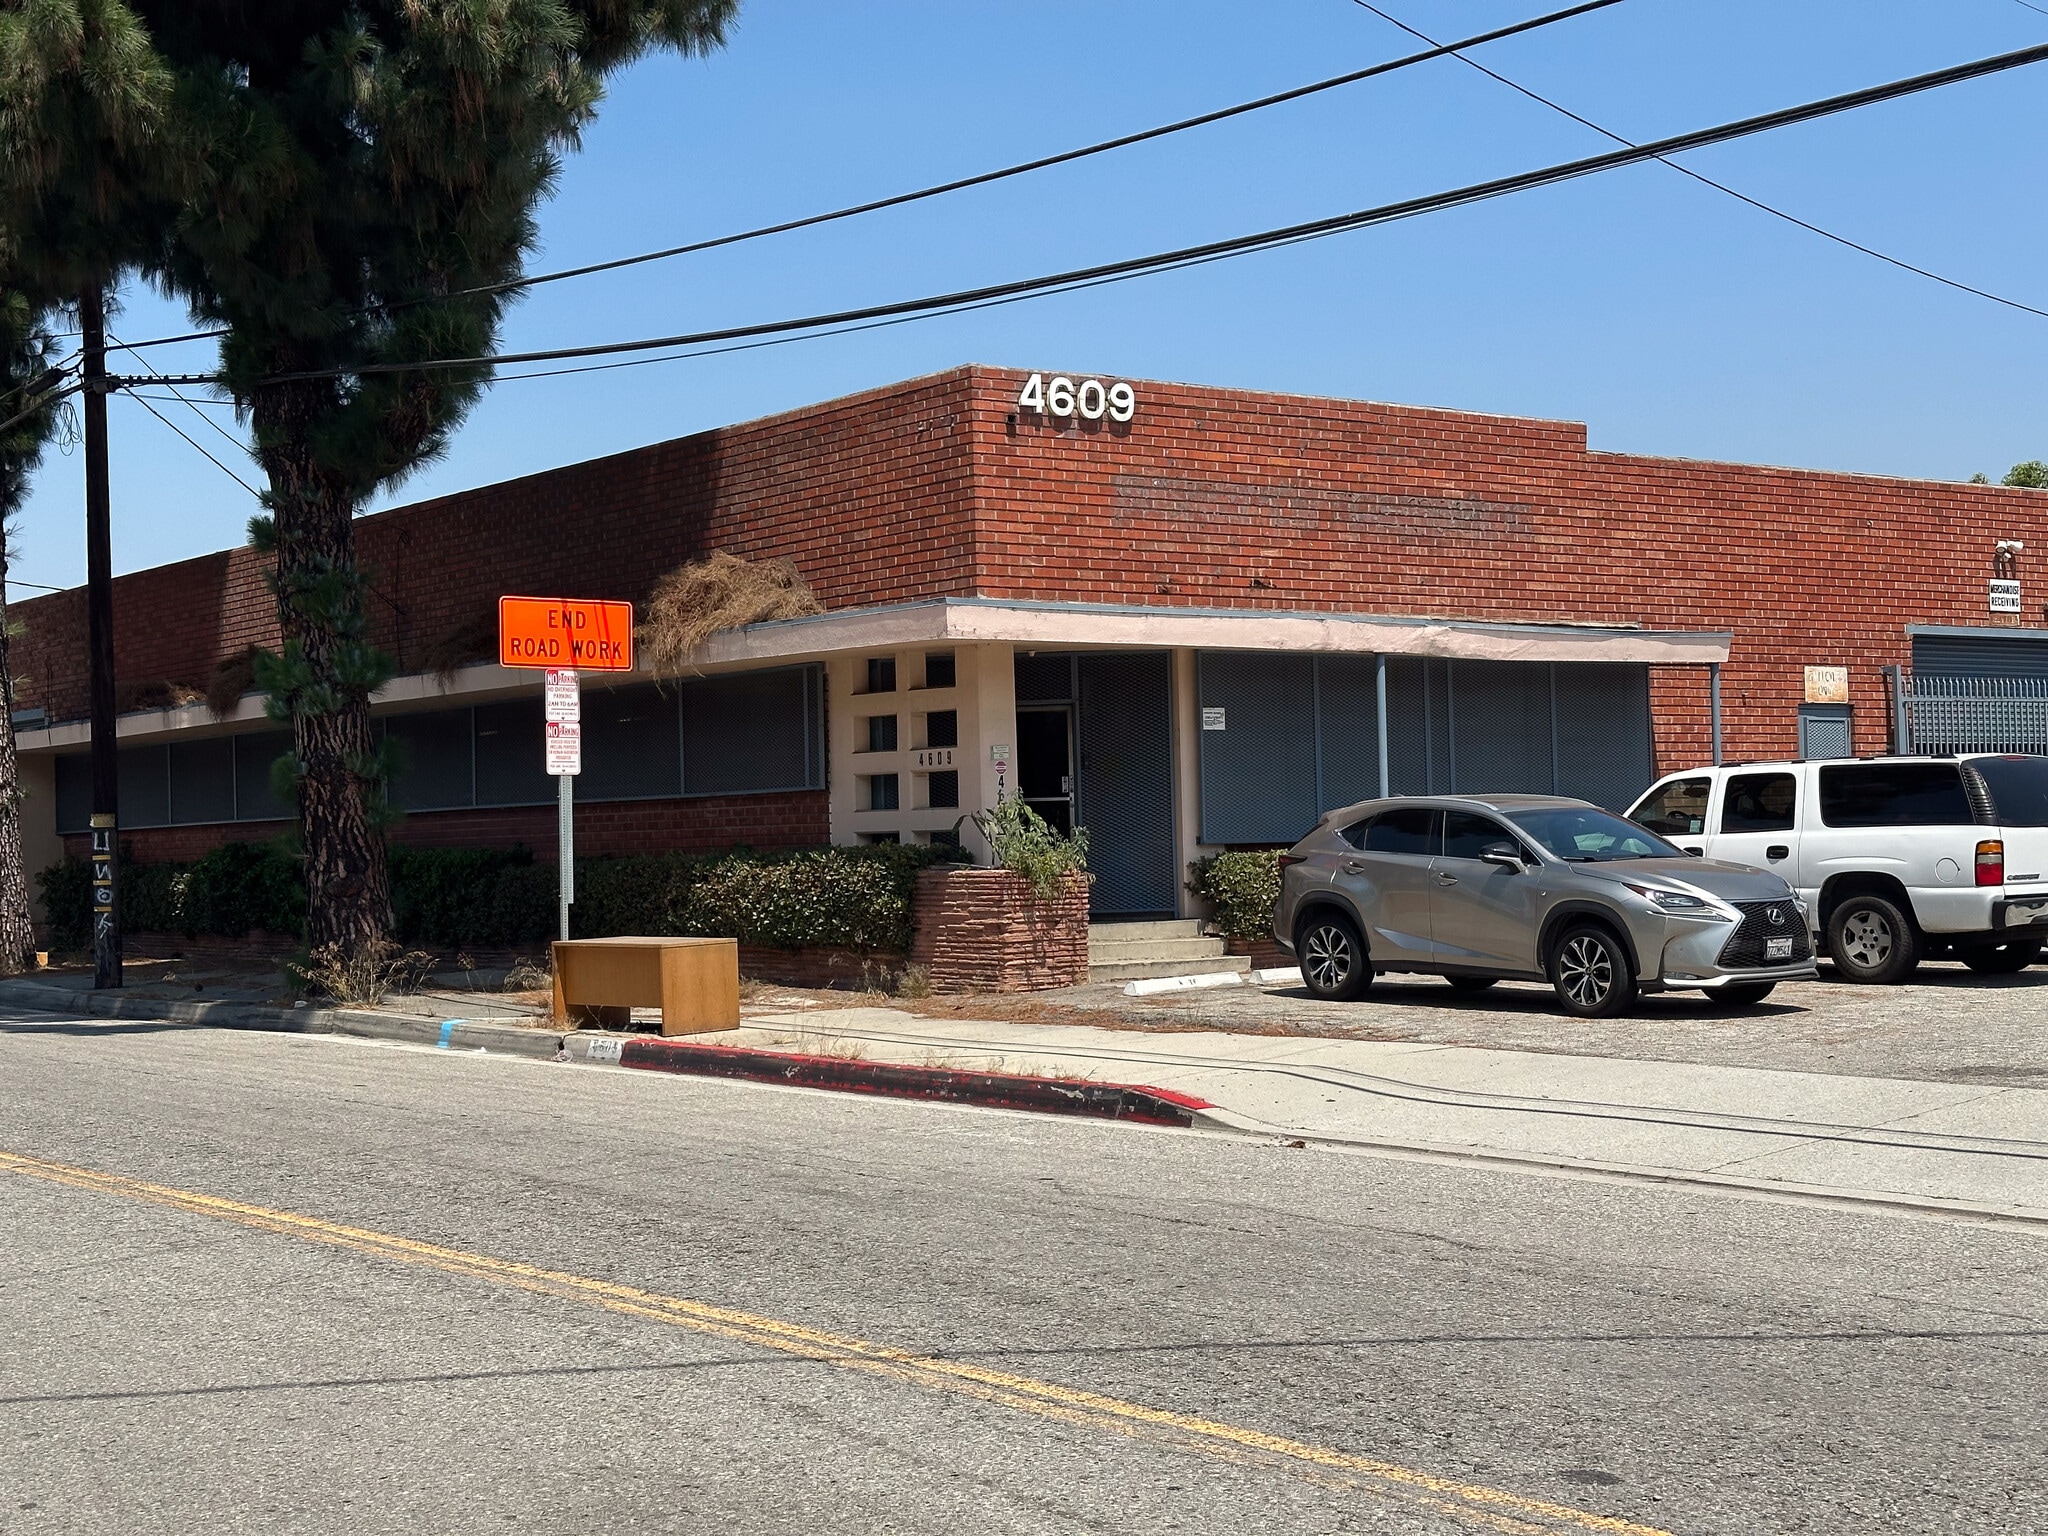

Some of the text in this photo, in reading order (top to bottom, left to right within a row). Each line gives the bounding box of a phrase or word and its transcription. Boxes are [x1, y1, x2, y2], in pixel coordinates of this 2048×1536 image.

[1018, 373, 1135, 422] 4609
[1990, 584, 2019, 595] MERCHANDISE
[1991, 596, 2019, 607] RECEIVING
[548, 609, 586, 630] END
[510, 637, 622, 660] ROAD WORK
[547, 673, 578, 685] NO PARKING
[548, 725, 579, 738] NO PARKING
[919, 750, 952, 767] 4609
